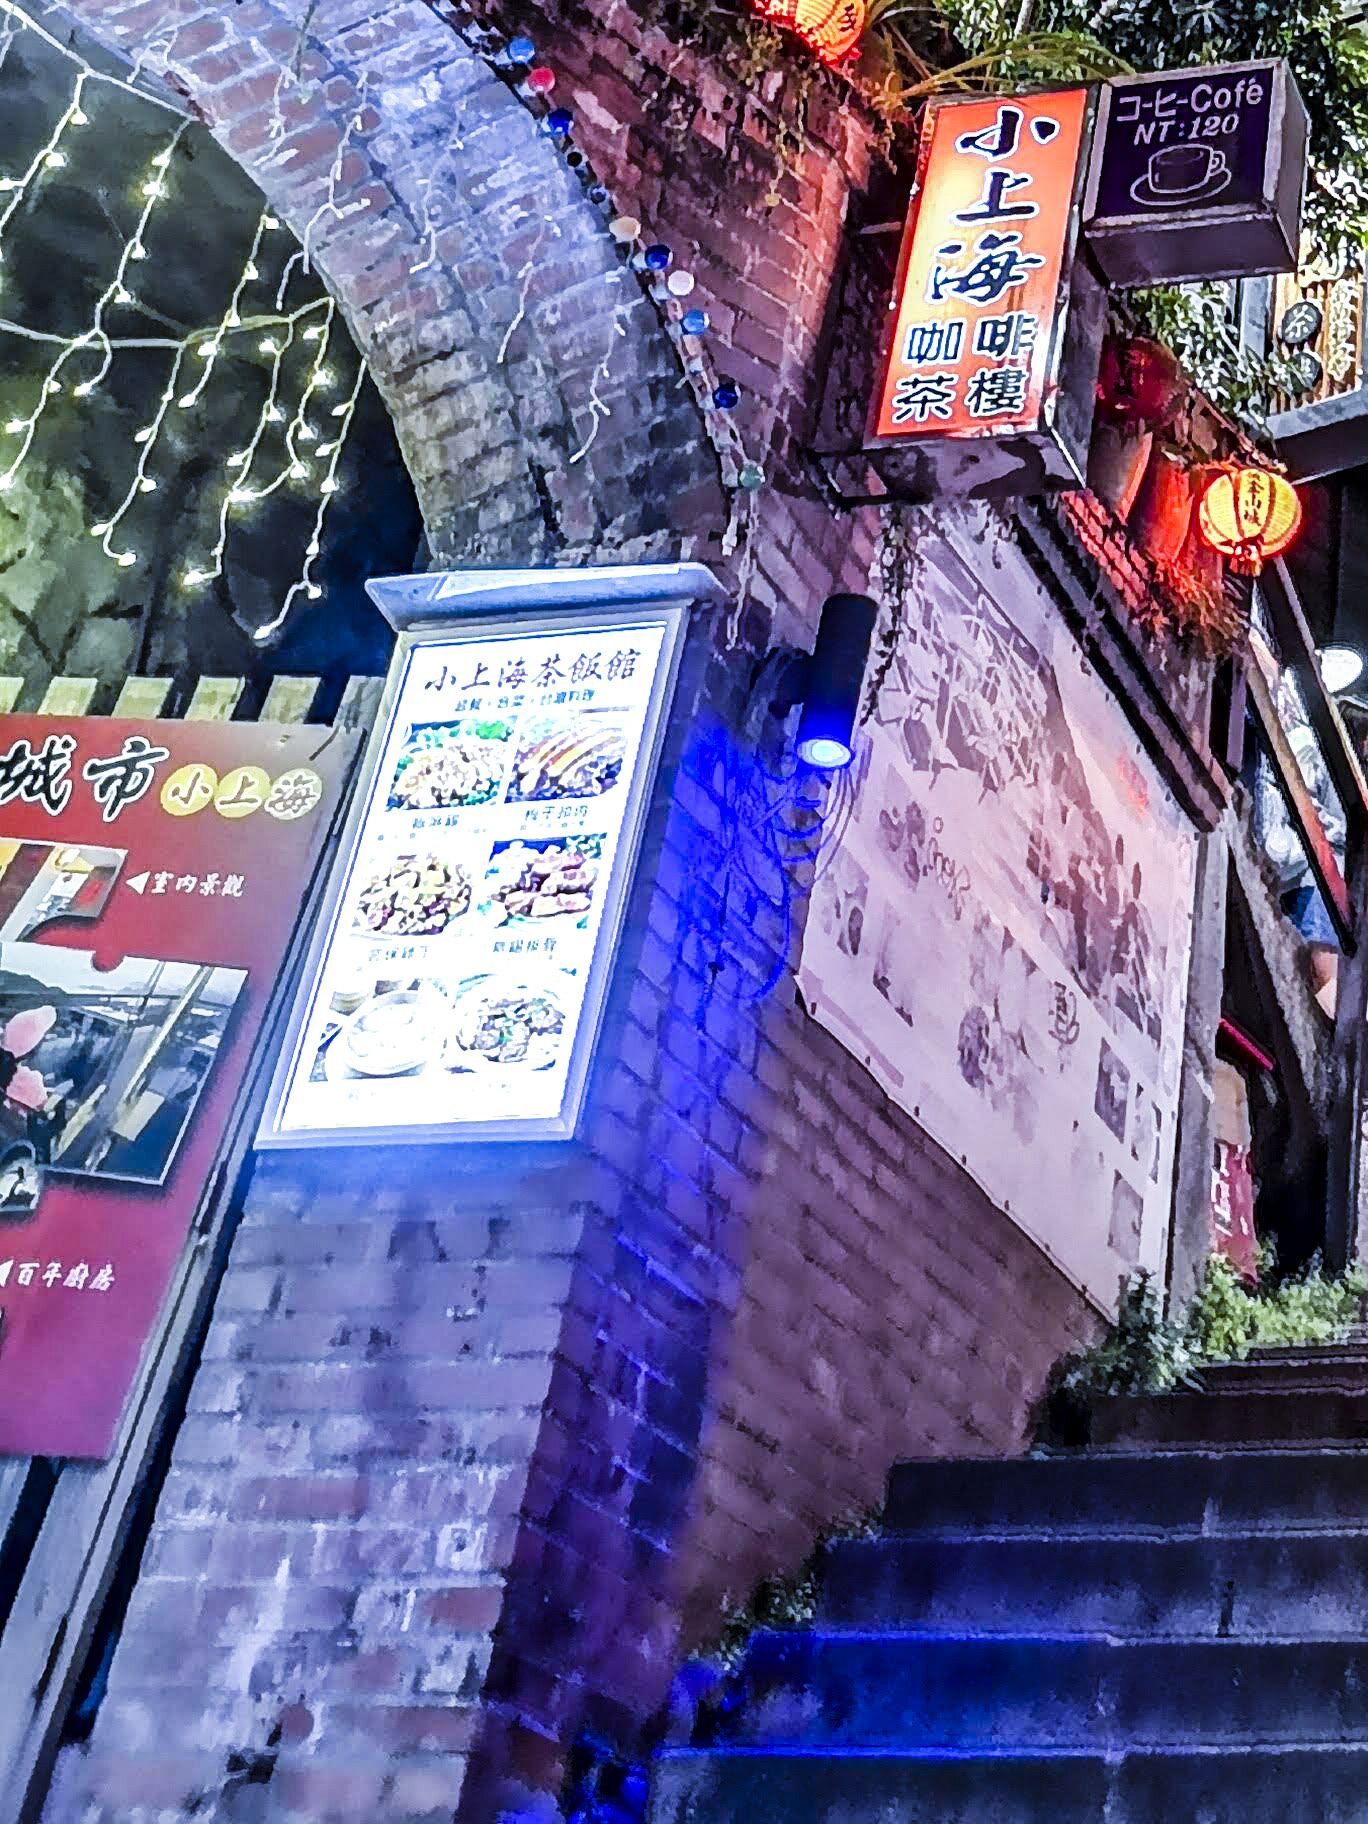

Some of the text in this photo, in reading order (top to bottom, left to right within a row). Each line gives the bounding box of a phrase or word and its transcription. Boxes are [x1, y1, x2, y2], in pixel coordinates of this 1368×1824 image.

[927, 106, 1060, 306] 小上海
[424, 648, 641, 691] 小上海茶飯館
